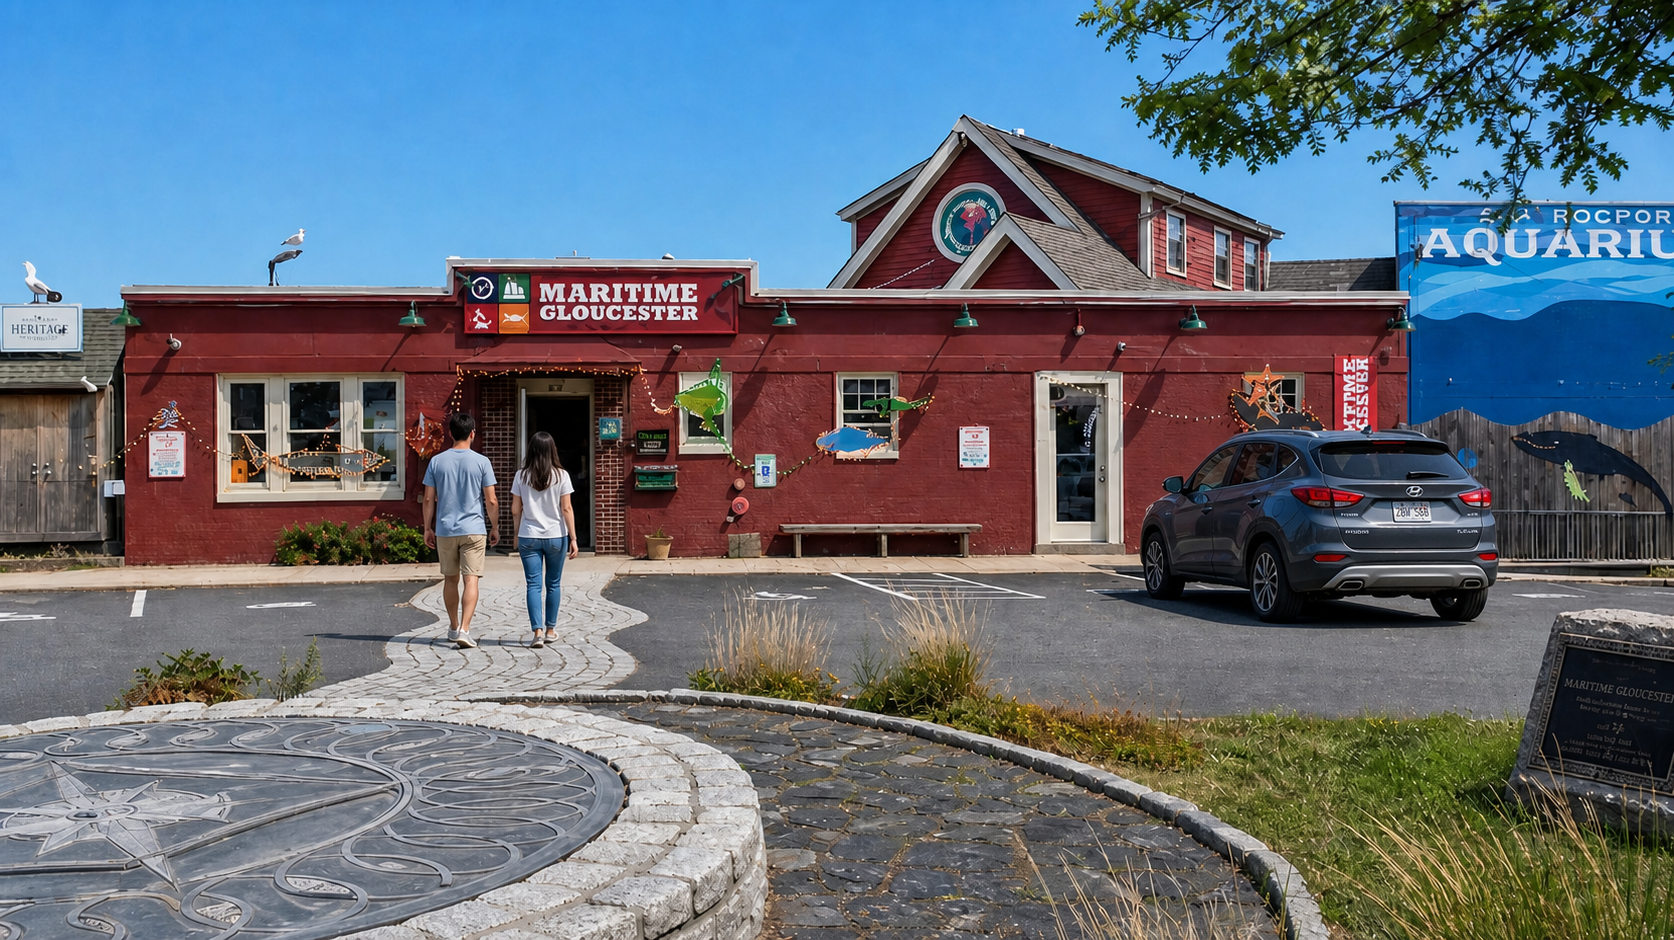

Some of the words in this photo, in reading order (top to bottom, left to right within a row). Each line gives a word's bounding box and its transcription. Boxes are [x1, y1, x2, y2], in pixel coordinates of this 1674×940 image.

[539, 283, 698, 303] MARITIME
[539, 305, 699, 321] GLOUCESTER
[11, 323, 69, 335] HERITAGE
[1564, 678, 1615, 694] MARITIME
